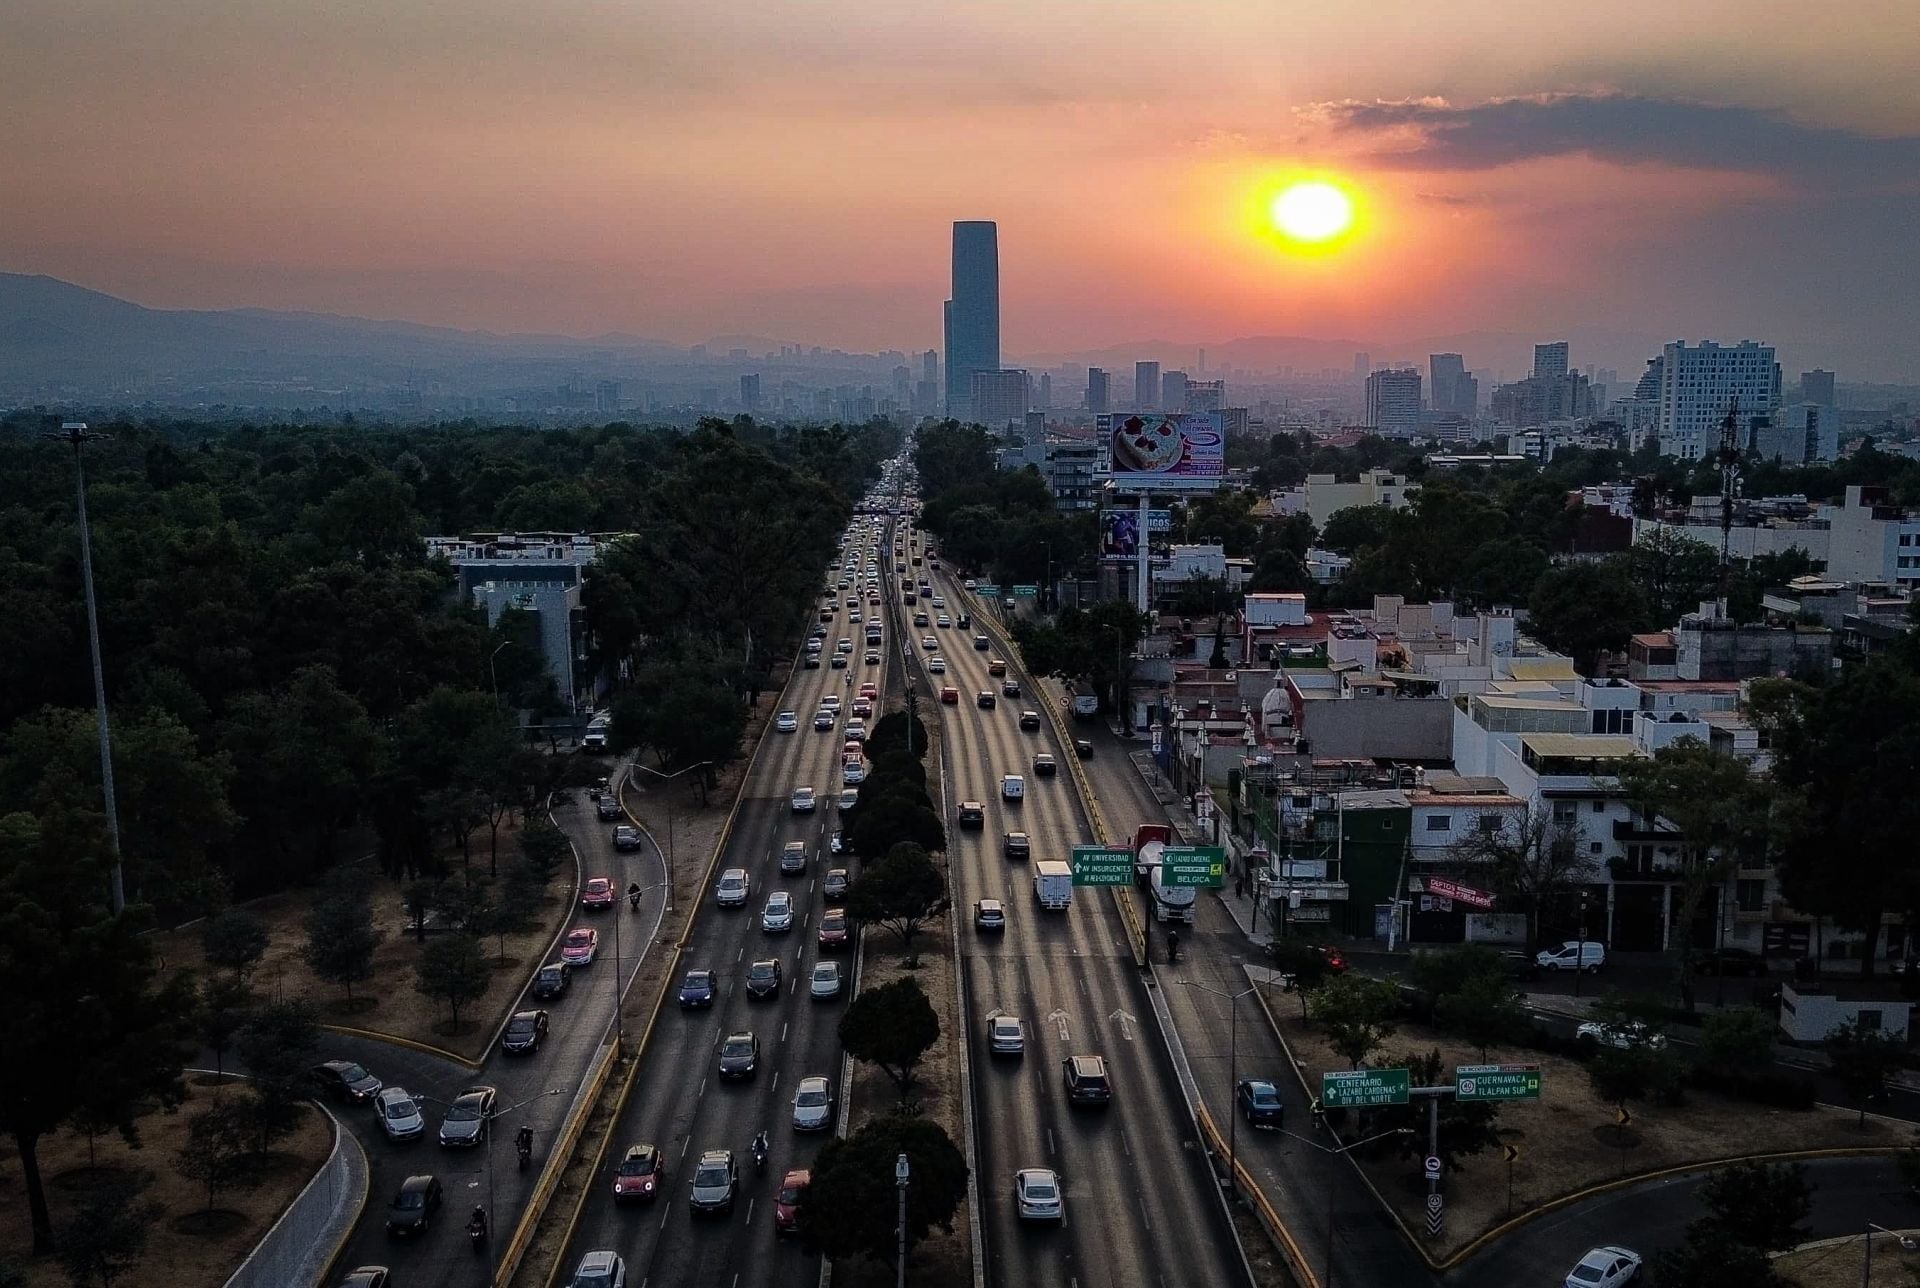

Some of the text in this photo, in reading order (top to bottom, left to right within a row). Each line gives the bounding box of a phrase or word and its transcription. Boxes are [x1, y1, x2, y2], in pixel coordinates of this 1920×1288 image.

[1337, 1078, 1382, 1087] CENTENARIO
[1477, 1075, 1526, 1085] CUERNAVACA
[1364, 1085, 1396, 1095] CARDENAS
[1478, 1086, 1526, 1096] TLALPAN SUR
[1355, 1095, 1367, 1104] DEL
[1371, 1094, 1392, 1104] NORTE
